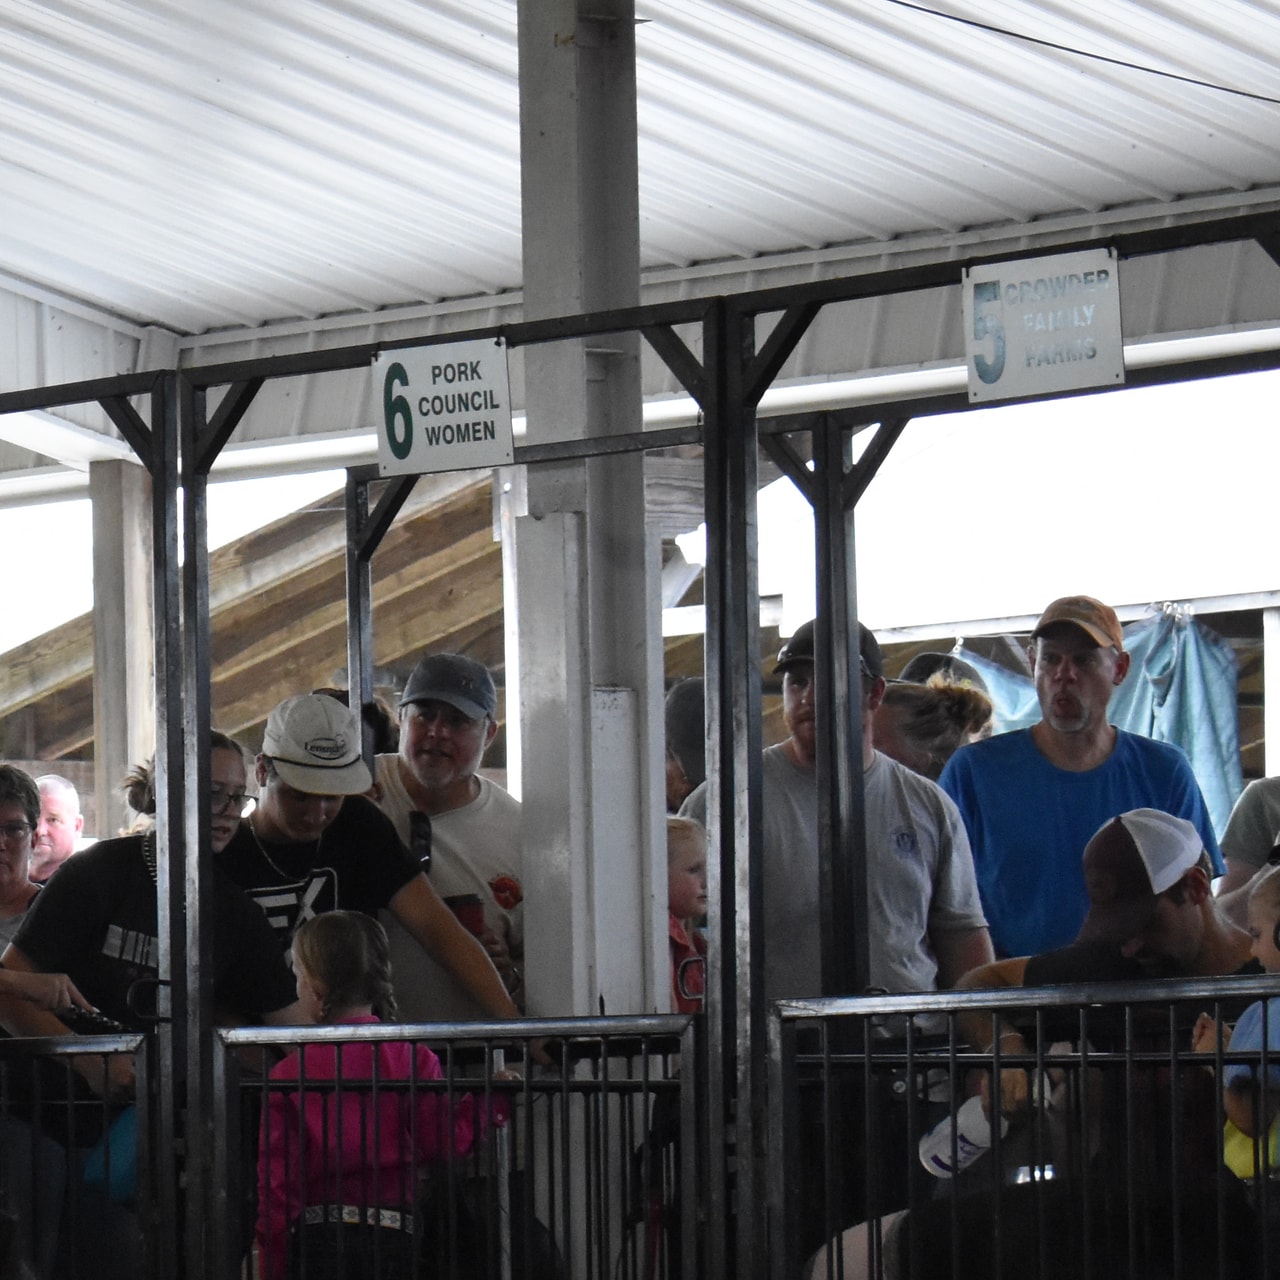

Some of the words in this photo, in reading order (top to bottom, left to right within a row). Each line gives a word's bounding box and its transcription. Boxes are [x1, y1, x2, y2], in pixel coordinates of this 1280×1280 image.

[1023, 304, 1095, 332] FAMILY
[973, 280, 1006, 385] 5
[1025, 337, 1097, 368] FARMS
[431, 360, 482, 385] PORK
[383, 361, 413, 460] 6
[418, 389, 500, 416] COUNCIL
[425, 420, 496, 446] WOMEN
